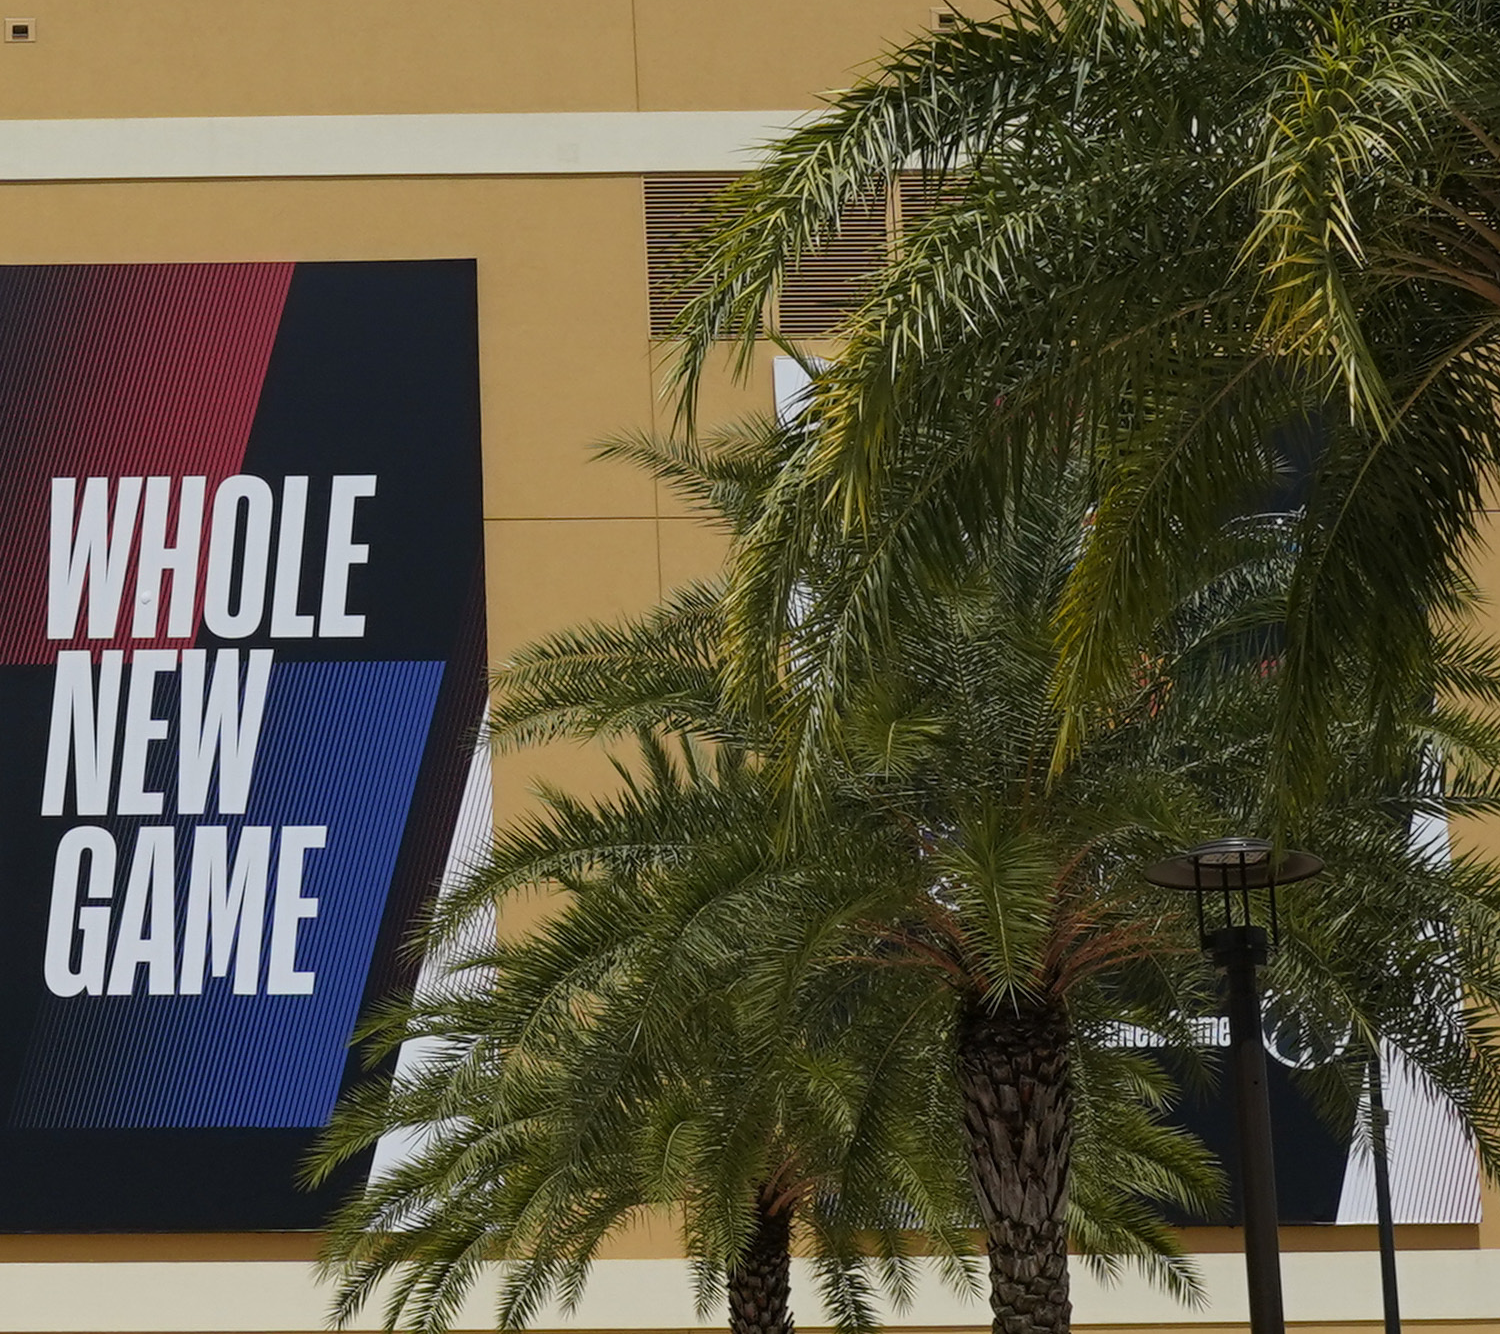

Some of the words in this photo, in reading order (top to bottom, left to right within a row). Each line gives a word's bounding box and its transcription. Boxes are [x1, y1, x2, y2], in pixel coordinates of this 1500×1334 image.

[47, 474, 377, 639] WHOLE
[41, 648, 274, 816] NEW
[44, 825, 328, 997] GAME
